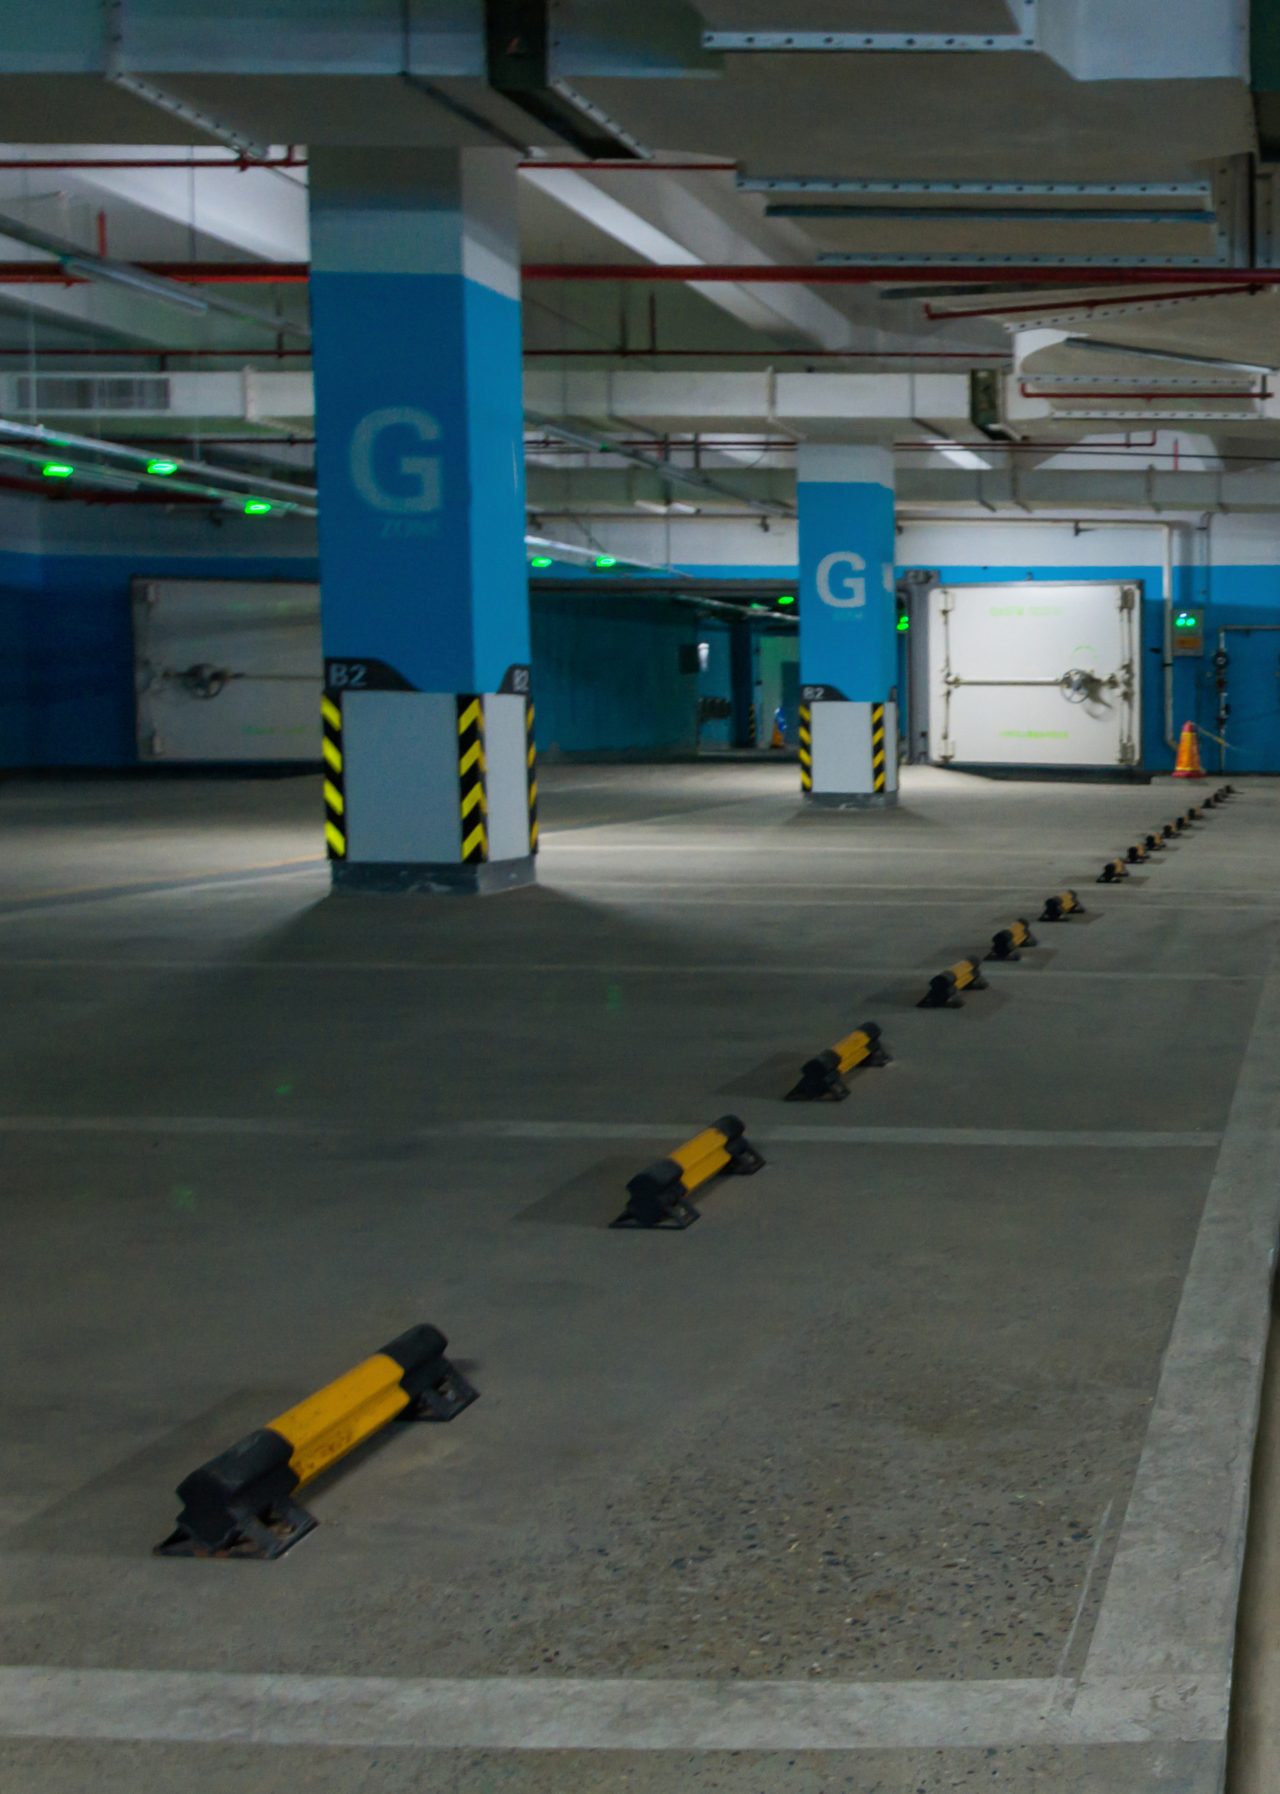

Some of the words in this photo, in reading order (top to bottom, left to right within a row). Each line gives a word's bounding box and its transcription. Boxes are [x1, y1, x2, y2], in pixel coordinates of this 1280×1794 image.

[350, 406, 442, 513] G
[816, 551, 866, 608] G
[329, 663, 368, 687] B2
[802, 686, 825, 699] B2
